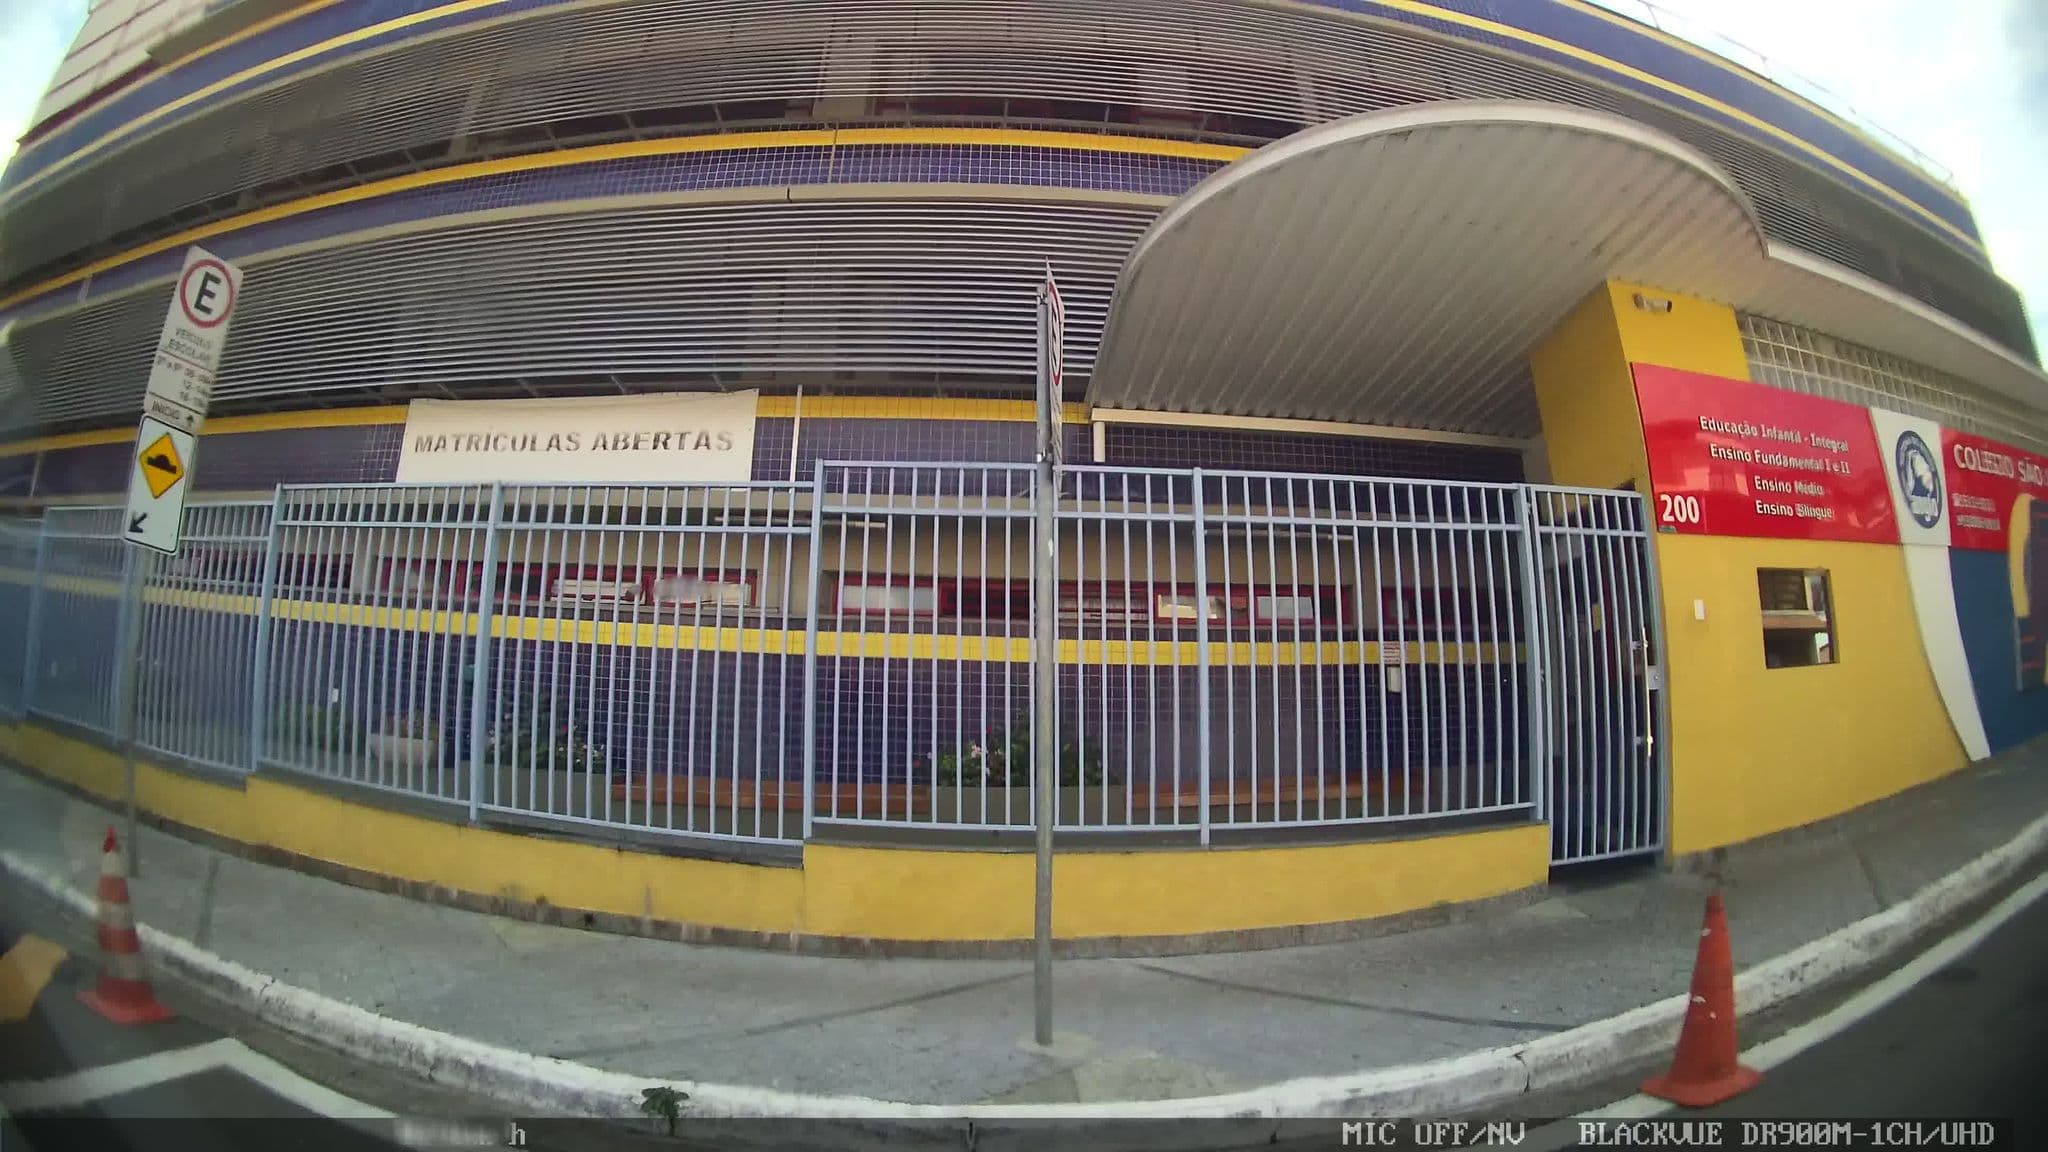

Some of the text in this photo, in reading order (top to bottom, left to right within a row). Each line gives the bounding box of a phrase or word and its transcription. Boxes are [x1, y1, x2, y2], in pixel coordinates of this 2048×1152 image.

[193, 270, 222, 315] E
[592, 430, 734, 452] ABERTAS
[1699, 416, 1757, 437] Educação
[1761, 424, 1801, 443] Infantil
[1810, 433, 1849, 453] Integral
[1709, 443, 1752, 462] Ensino
[1754, 449, 1823, 471] Fundamental
[1754, 475, 1792, 494] Ensino
[1660, 493, 1700, 525] 200
[1755, 499, 1793, 517] Ensino
